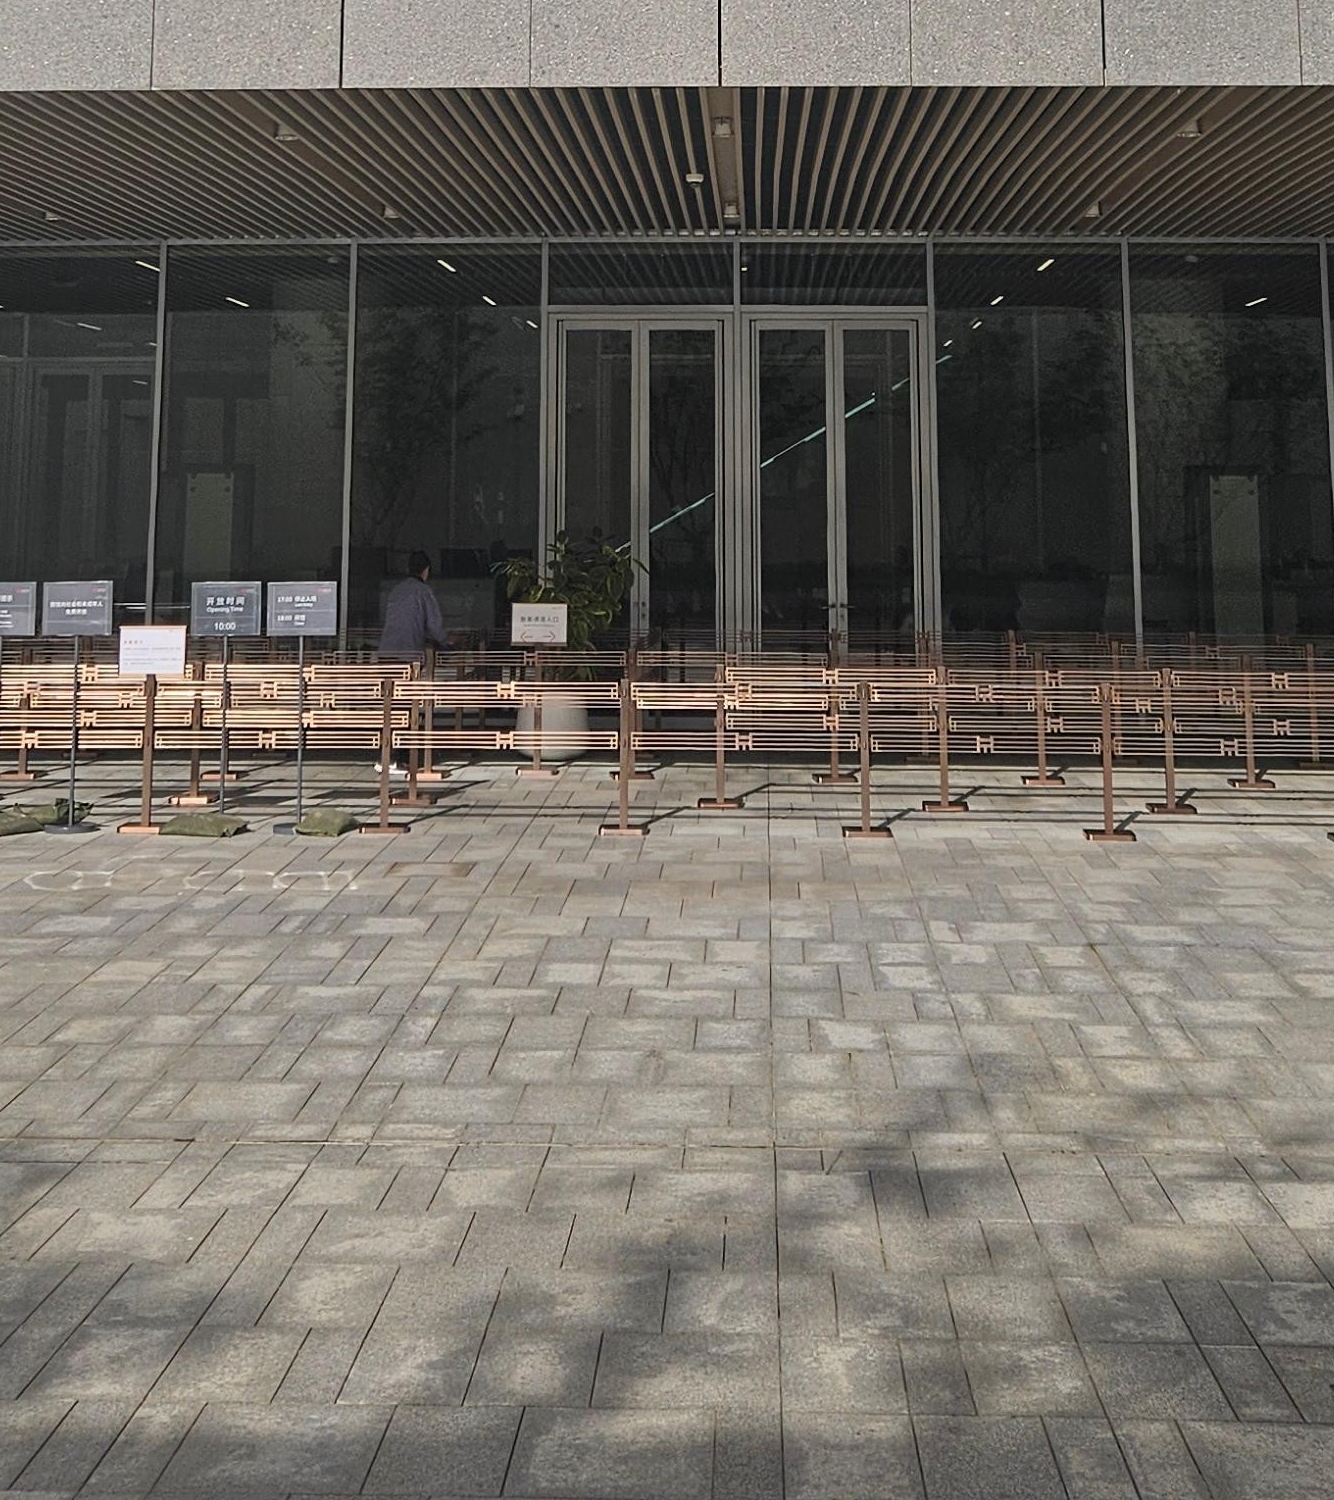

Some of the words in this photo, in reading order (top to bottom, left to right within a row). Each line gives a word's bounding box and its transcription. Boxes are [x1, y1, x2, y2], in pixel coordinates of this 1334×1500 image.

[206, 596, 245, 606] 开放时间
[214, 622, 236, 631] 10:00
